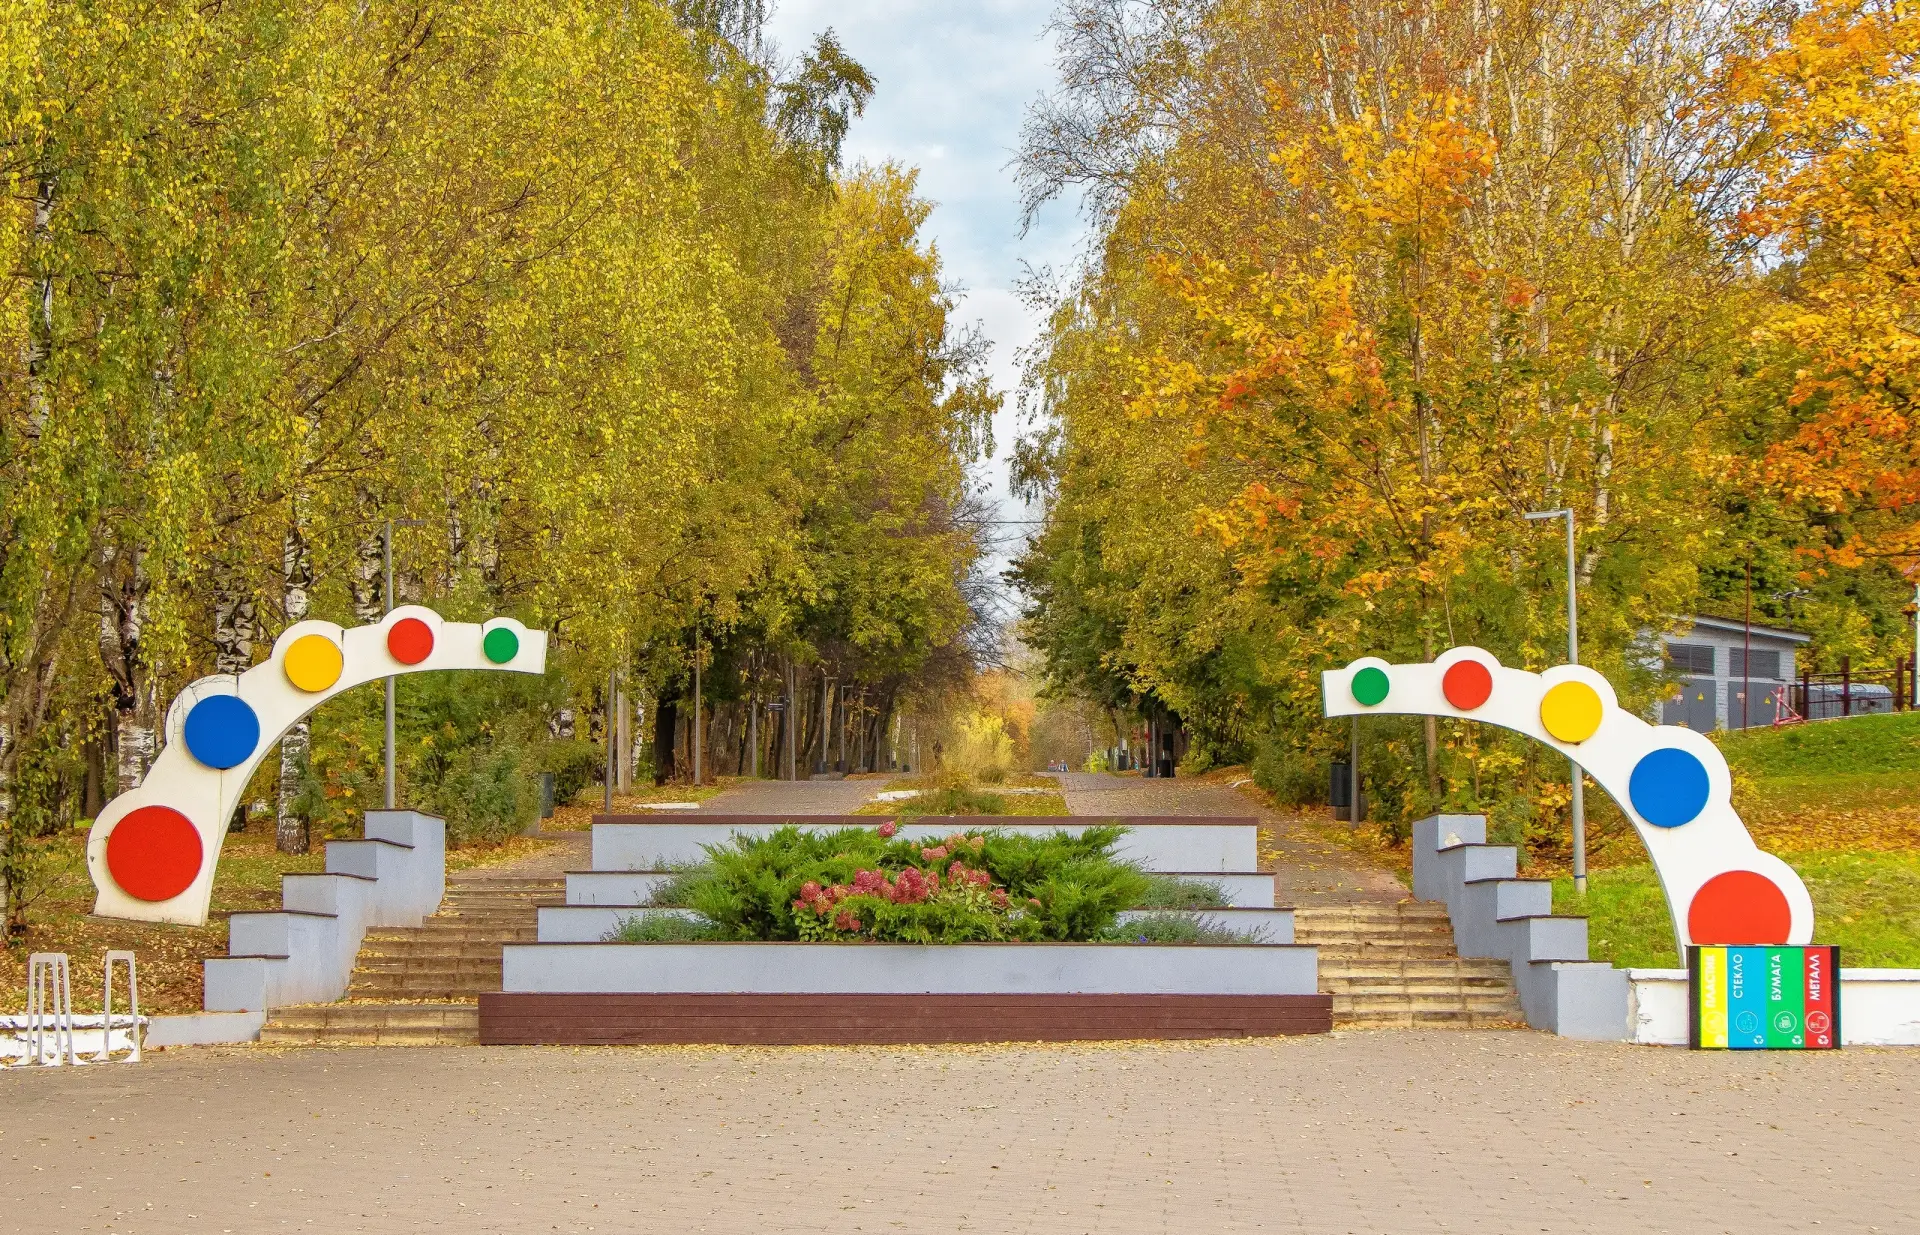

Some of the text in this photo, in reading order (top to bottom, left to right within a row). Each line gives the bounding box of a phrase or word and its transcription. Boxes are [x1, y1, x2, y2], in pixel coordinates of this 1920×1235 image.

[1733, 954, 1743, 999] СТЕКЛО
[1771, 954, 1781, 1001] БУМАГА
[1809, 954, 1820, 1001] МЕТАЛЛ
